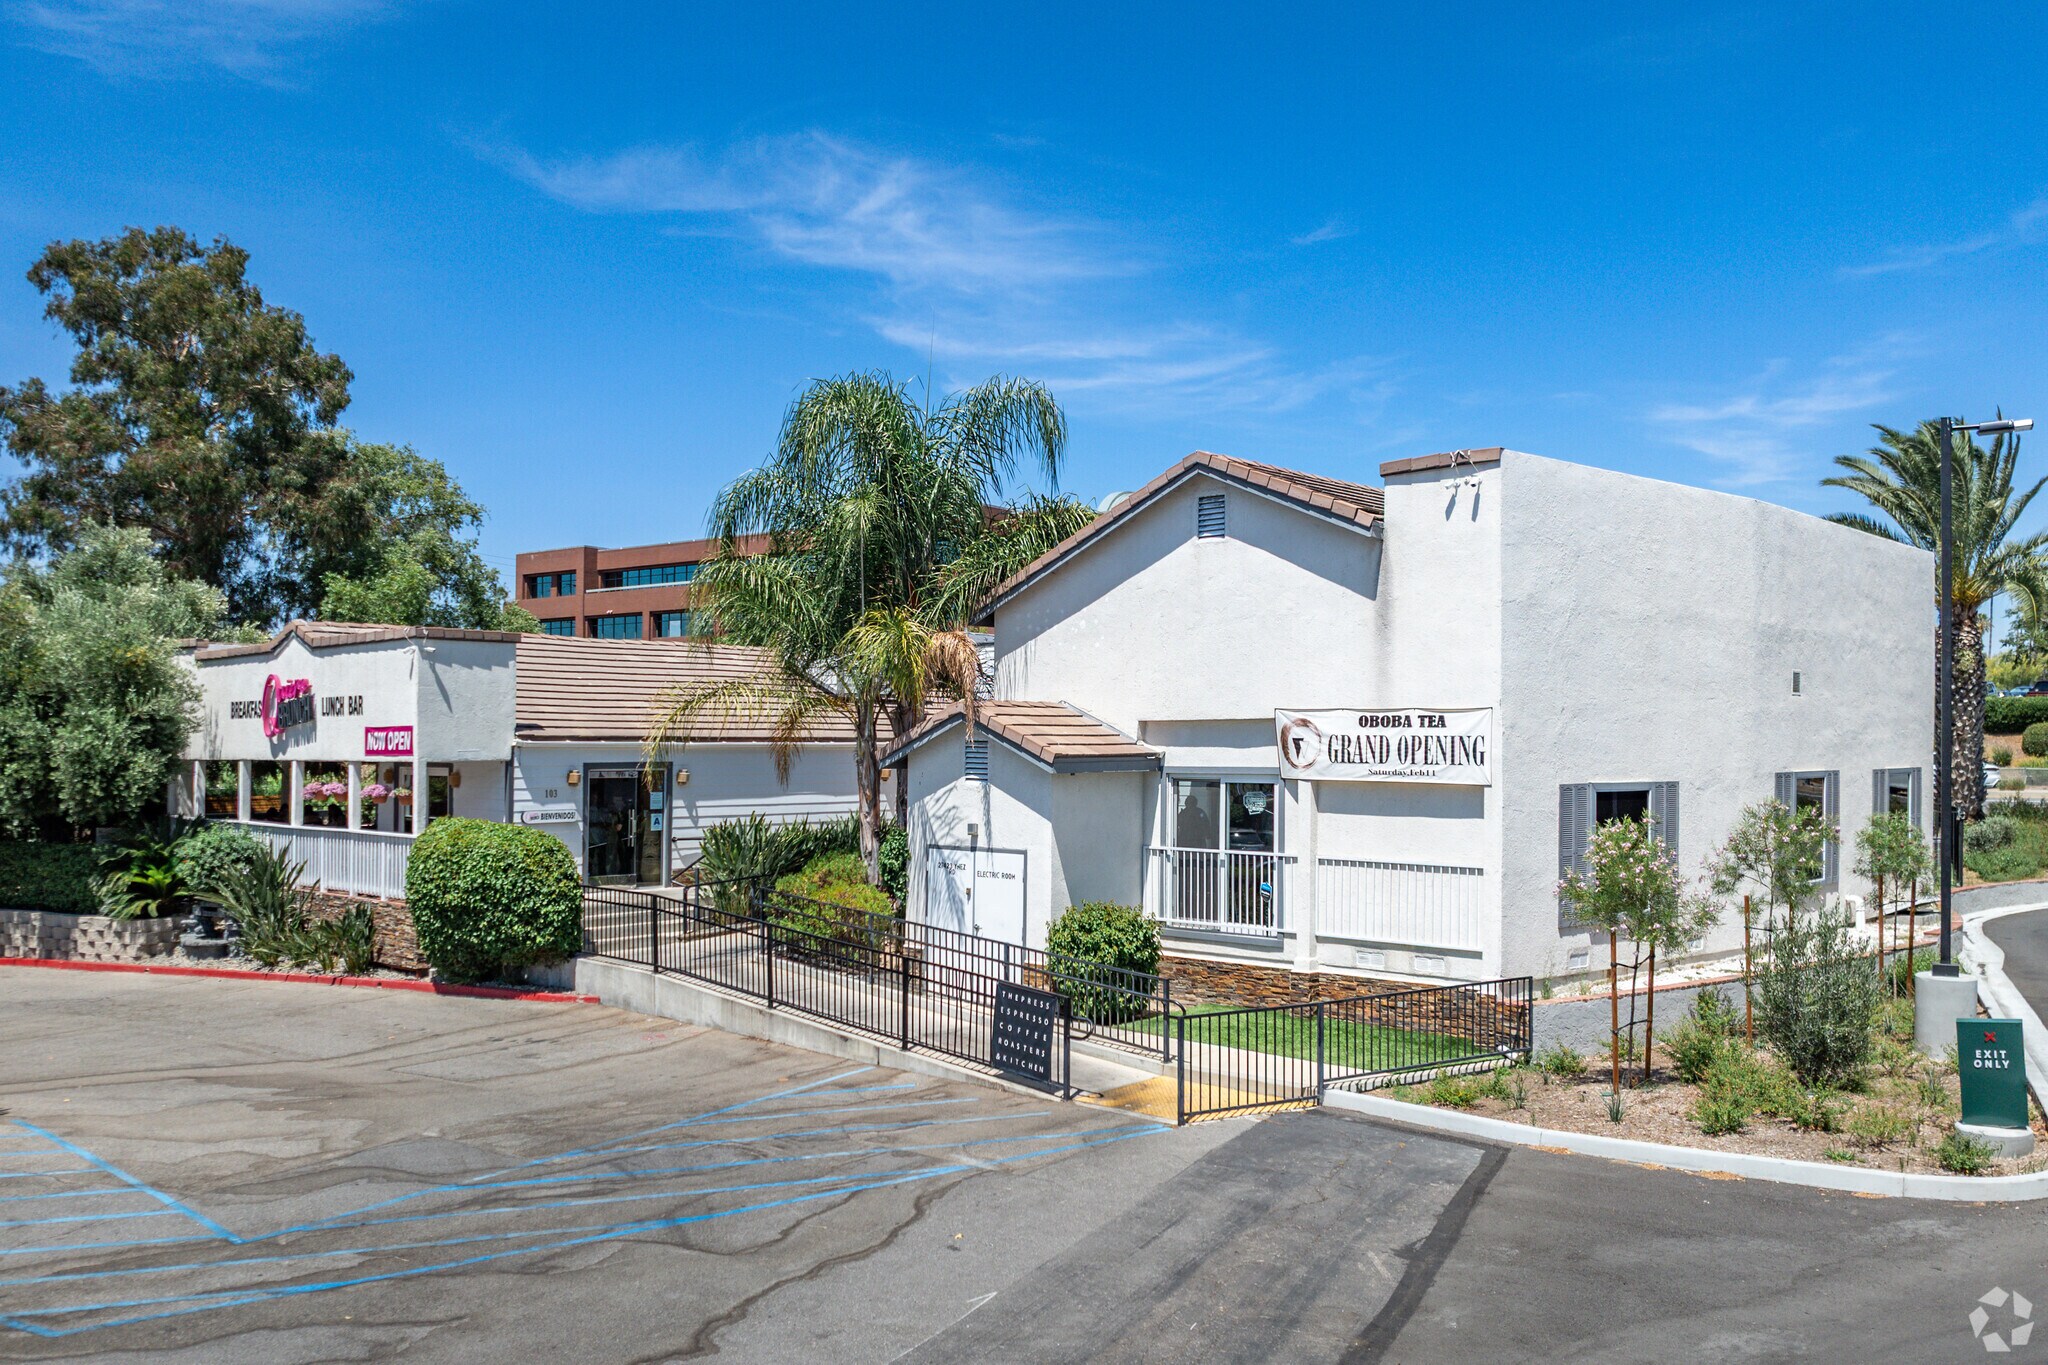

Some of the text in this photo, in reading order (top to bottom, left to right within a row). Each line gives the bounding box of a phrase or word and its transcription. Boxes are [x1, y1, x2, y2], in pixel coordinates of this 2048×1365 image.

[231, 701, 263, 719] BREAKFAS
[321, 695, 364, 717] LUNCH BAR
[1358, 714, 1447, 728] OBOBA TEA
[366, 730, 412, 751] NOW OPEN
[1327, 734, 1486, 767] GRAND OPENING
[544, 789, 558, 799] 103
[653, 817, 661, 826] A
[976, 870, 1016, 880] ELECTRIC ROOM
[1000, 1006, 1049, 1026] ESPRESSO
[999, 1021, 1047, 1042] COFFEE
[997, 1037, 1046, 1058] ROASTERS
[1975, 1049, 2007, 1059] EXIT
[1973, 1059, 2010, 1069] ONLY
